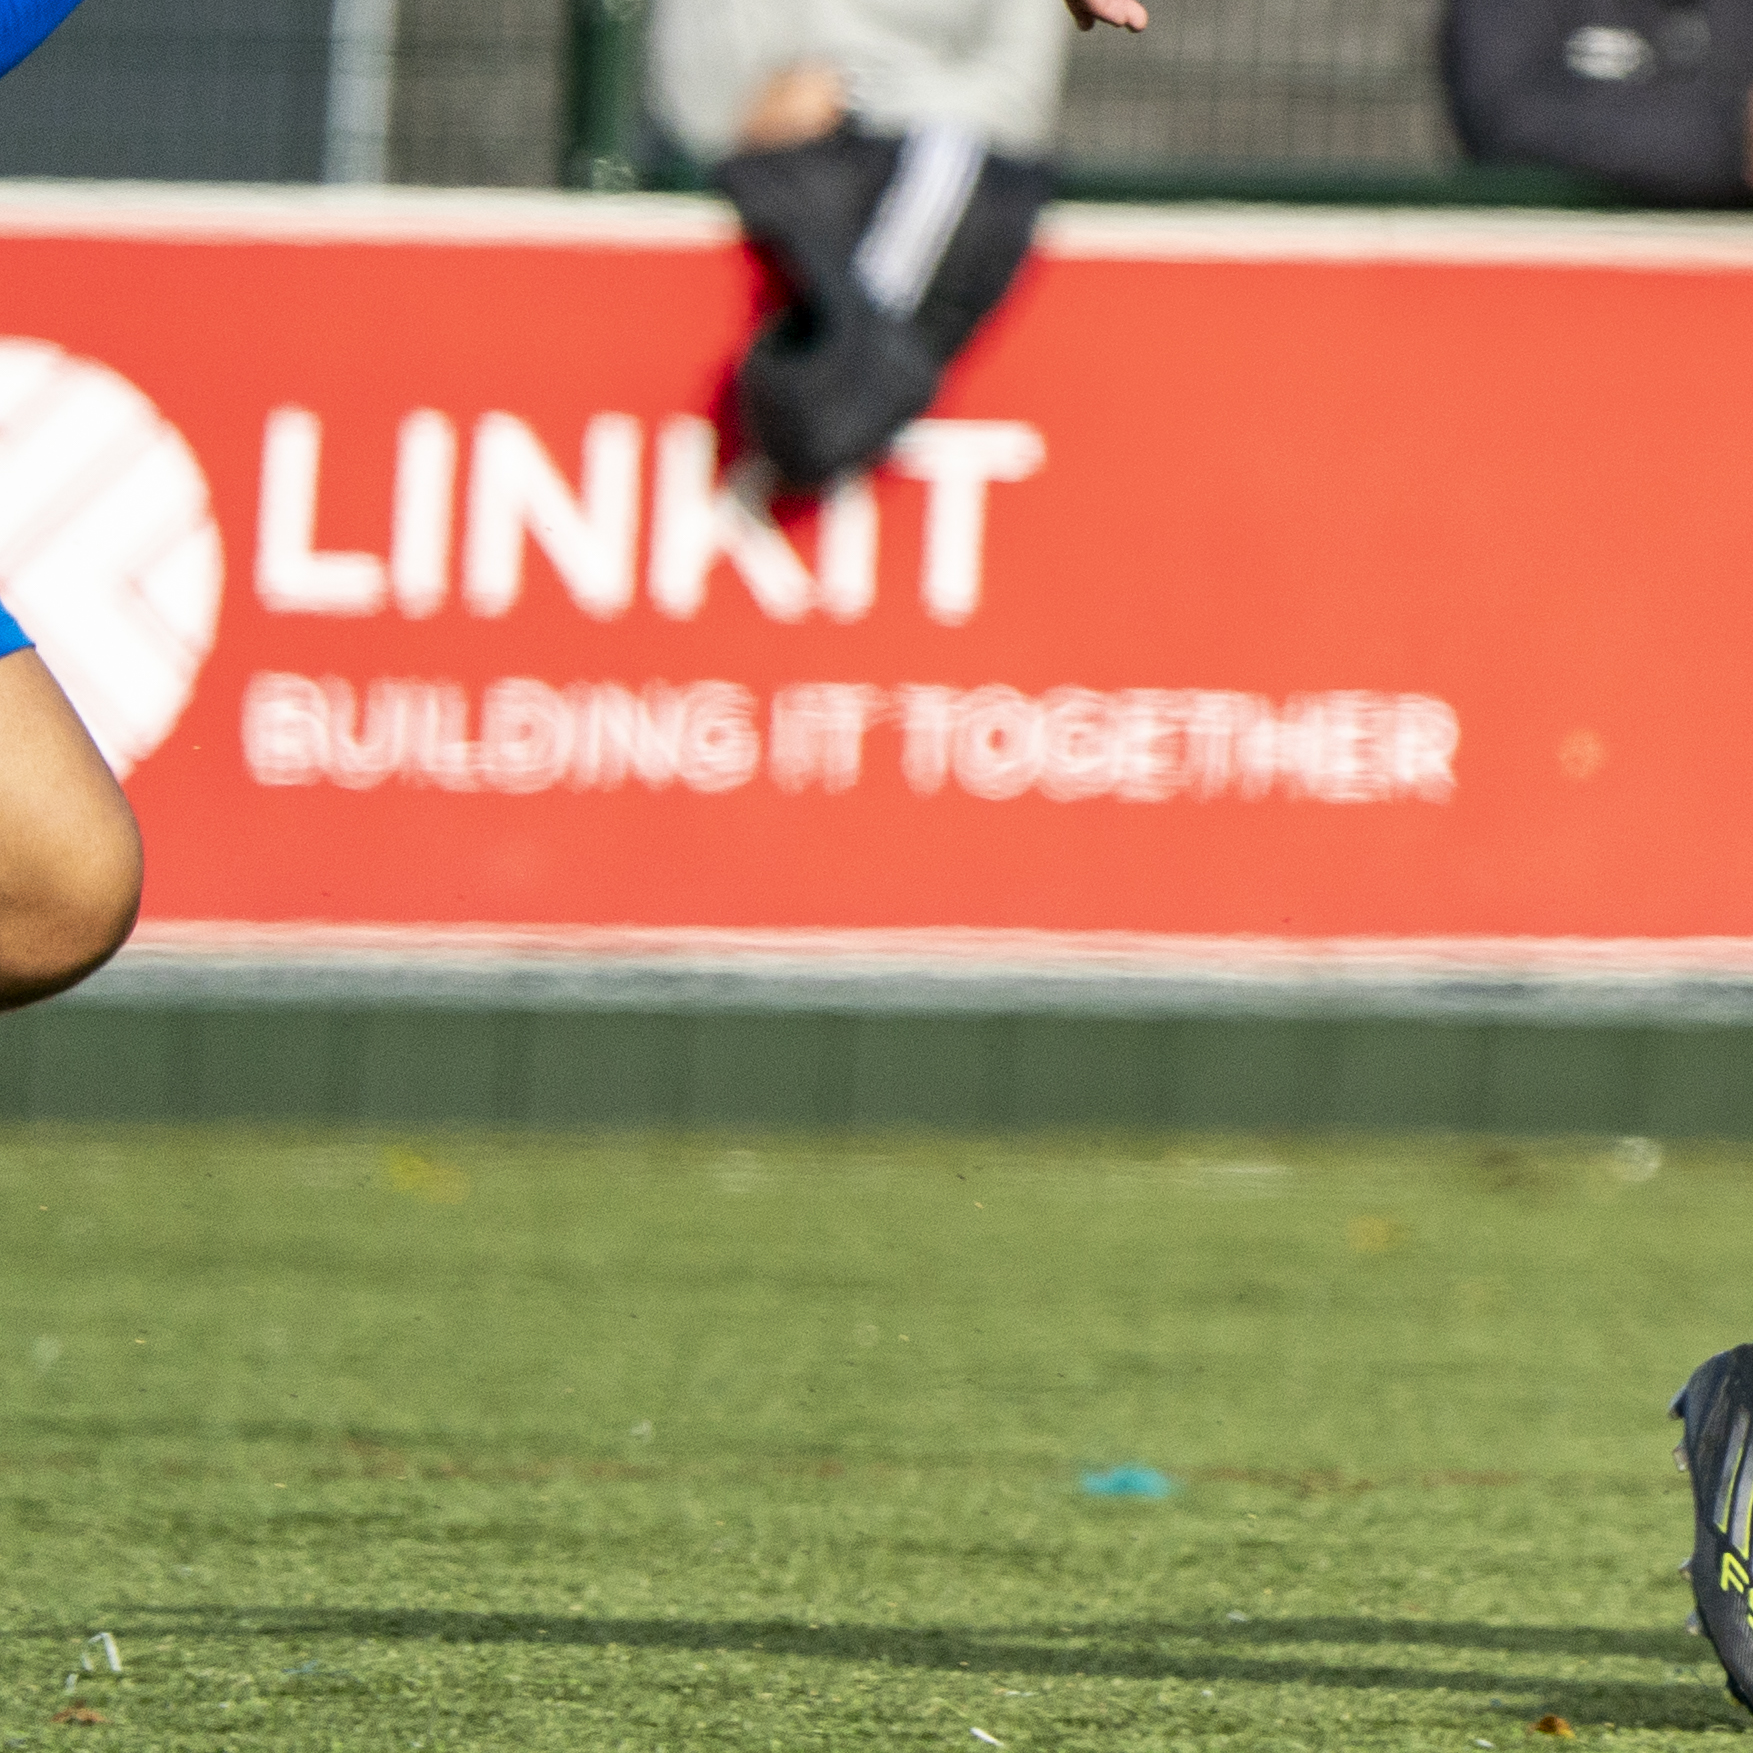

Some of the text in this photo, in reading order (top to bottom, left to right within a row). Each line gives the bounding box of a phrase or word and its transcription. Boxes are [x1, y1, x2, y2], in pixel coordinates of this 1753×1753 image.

[255, 403, 1047, 627] LINKIT
[242, 671, 1461, 805] BUILDING IT TOGETHER
